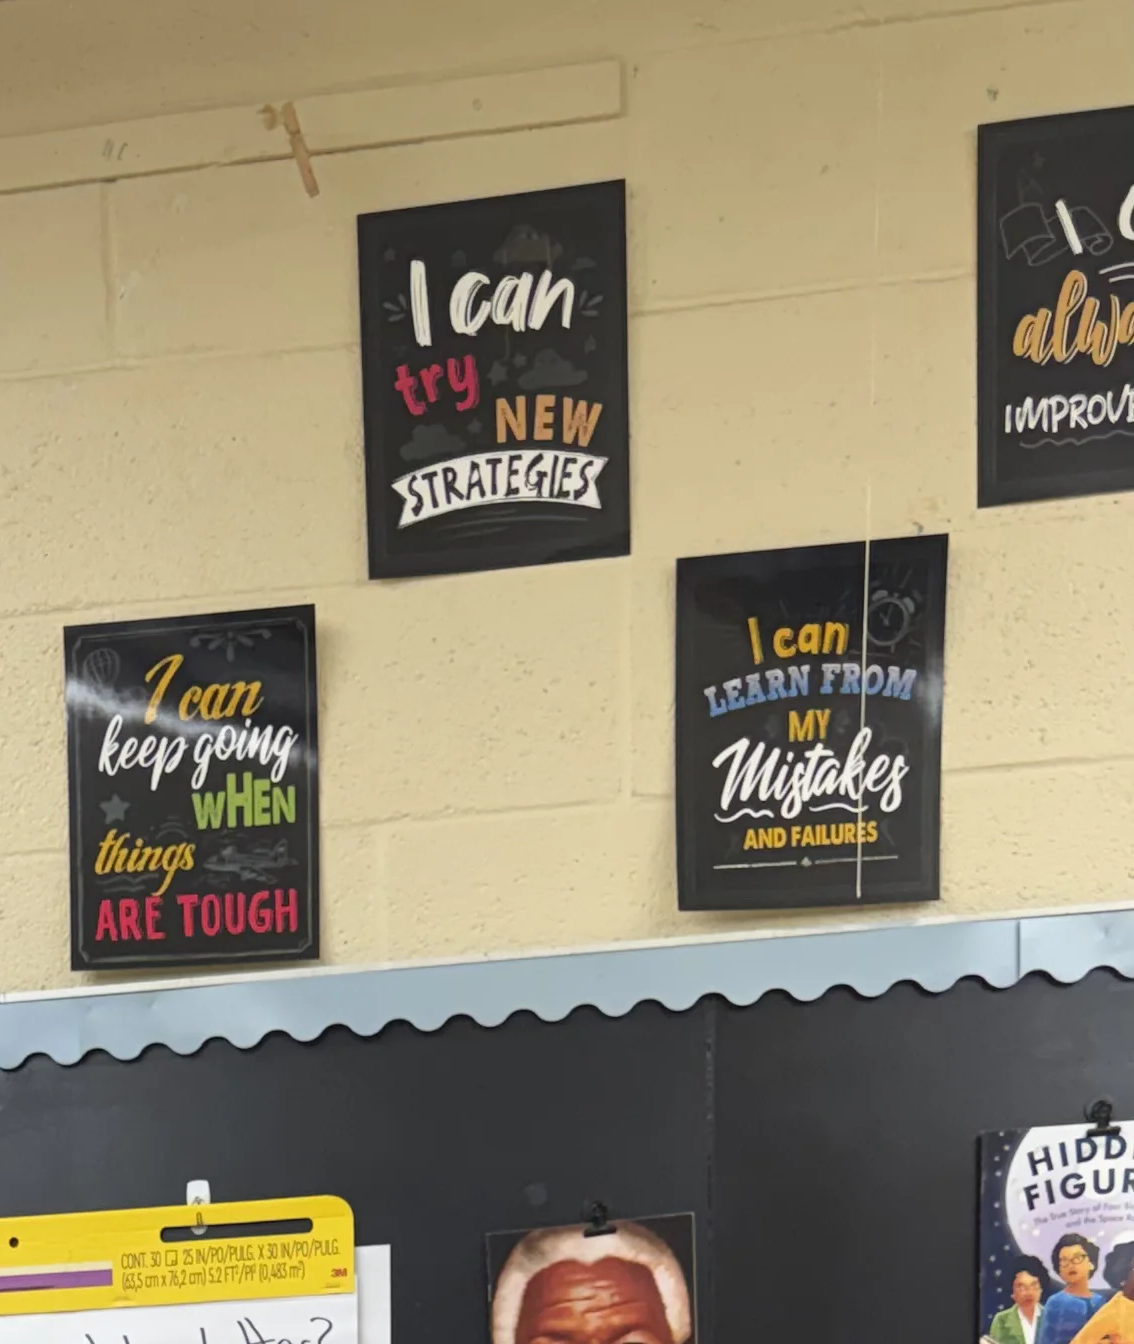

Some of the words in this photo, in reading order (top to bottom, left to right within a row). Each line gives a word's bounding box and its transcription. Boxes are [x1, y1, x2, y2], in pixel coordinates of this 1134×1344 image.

[1055, 198, 1084, 256] I
[410, 259, 433, 347] I
[449, 268, 576, 336] can
[394, 353, 481, 416] try
[495, 394, 604, 447] NEW
[407, 453, 595, 516] STRATEGIES
[746, 616, 765, 665] I
[772, 617, 850, 658] can
[144, 653, 184, 726] I
[179, 679, 264, 722] can
[703, 664, 811, 718] LEARN
[820, 662, 919, 701] FROM
[98, 713, 189, 792] keep
[191, 718, 300, 791] going
[787, 707, 832, 742] MY
[711, 726, 911, 820] Mistakes
[93, 828, 197, 897] things
[742, 827, 788, 851] AND
[790, 821, 879, 848] FAILURES
[94, 895, 166, 942] ARE
[176, 888, 300, 938] TOUGH
[1026, 1131, 1134, 1177] HIDD
[121, 1251, 150, 1270] CONT.
[150, 1249, 162, 1268] 30
[183, 1247, 194, 1266] 25
[266, 1239, 279, 1256] 30
[330, 1267, 349, 1278] 3M
